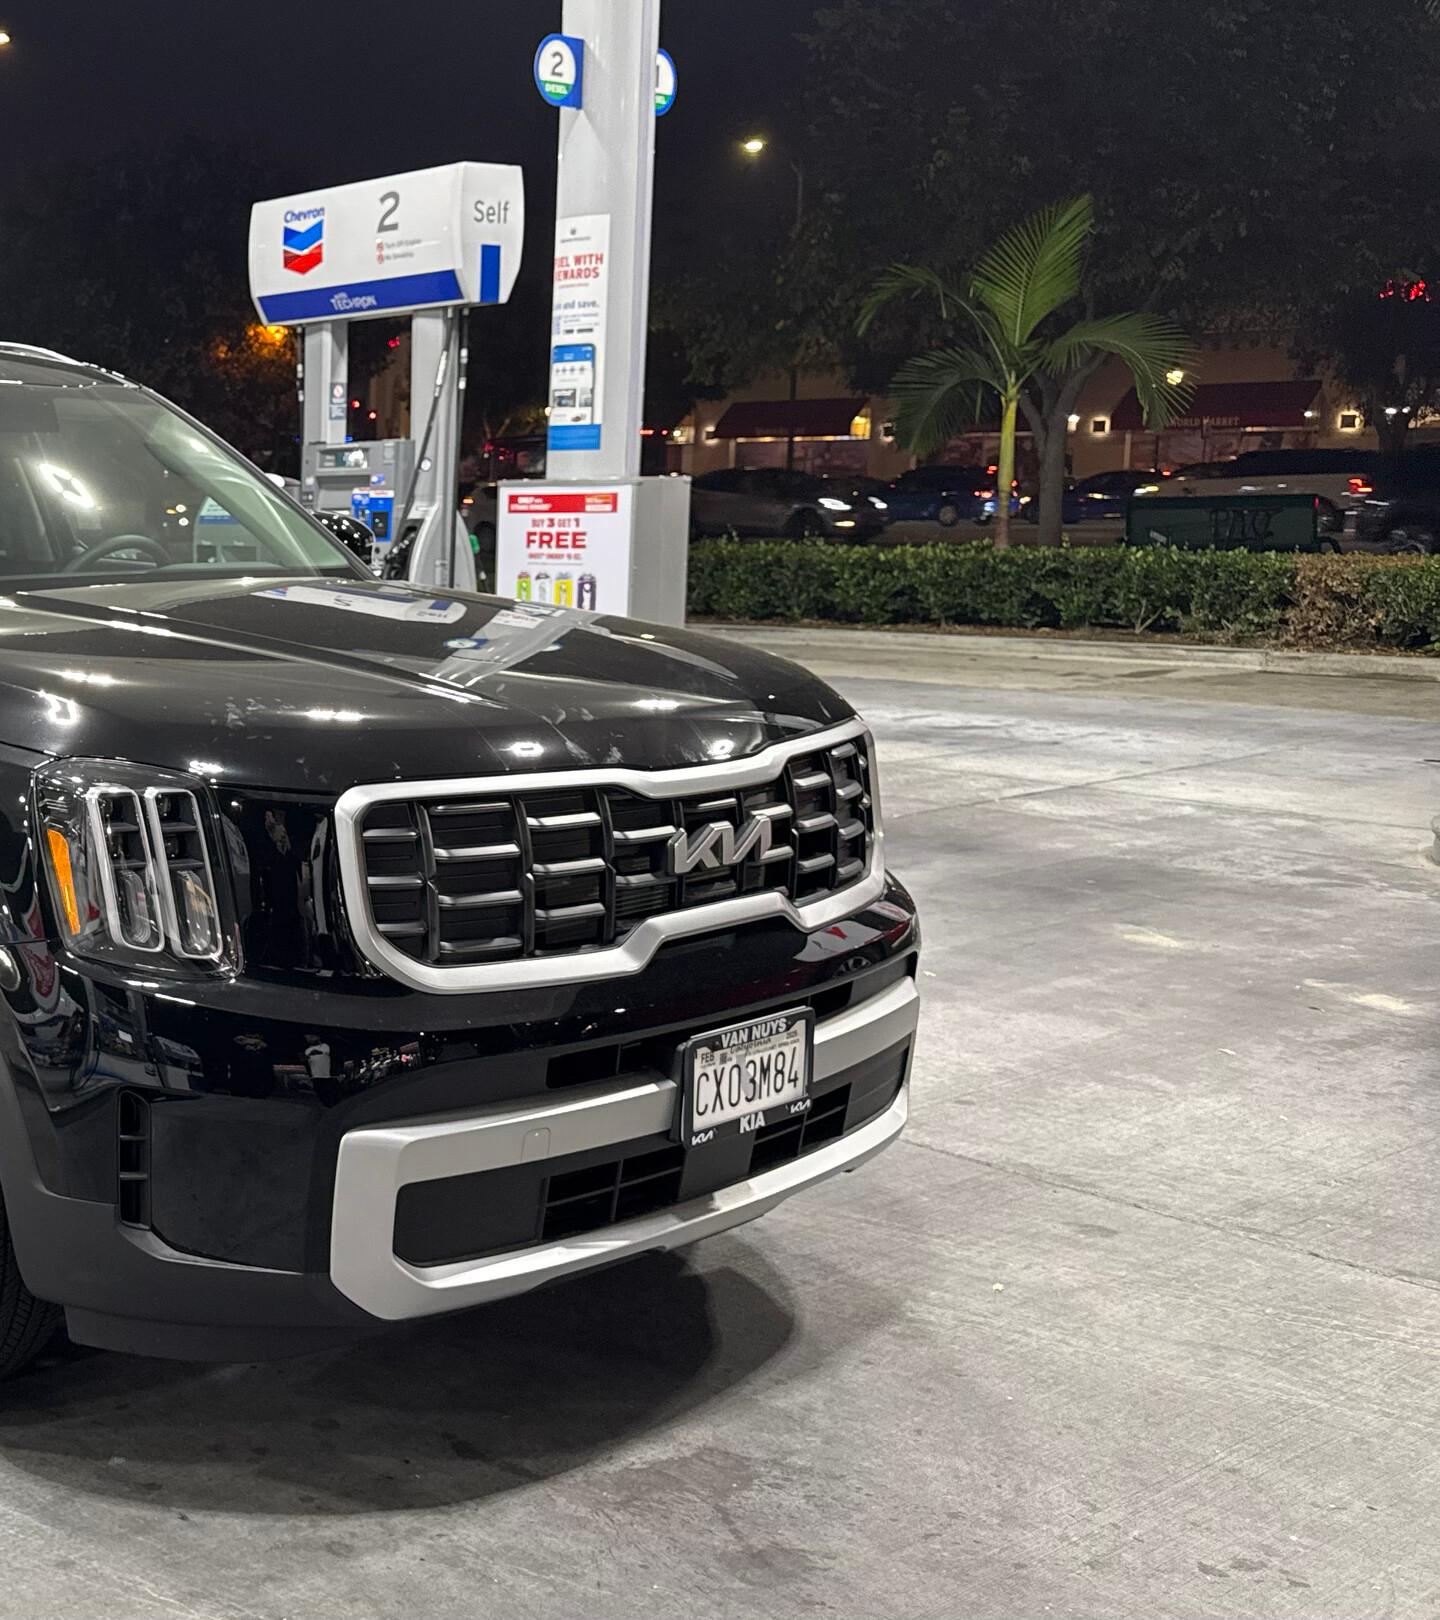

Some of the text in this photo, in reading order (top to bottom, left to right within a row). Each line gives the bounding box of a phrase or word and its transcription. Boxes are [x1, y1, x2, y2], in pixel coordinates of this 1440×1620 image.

[550, 51, 564, 77] 2
[283, 206, 325, 224] Chevron
[376, 191, 401, 233] 2
[473, 200, 511, 225] Self
[574, 253, 604, 266] WITH
[555, 267, 600, 281] EWARDS
[330, 294, 377, 311] TECHRON
[532, 517, 580, 528] BUY 3 GET 1
[525, 531, 587, 550] FREE
[667, 814, 772, 875] KIA
[721, 1028, 750, 1048] VAN
[751, 1018, 787, 1042] NUYS
[700, 1050, 715, 1064] FEB
[739, 1111, 766, 1134] KIA
